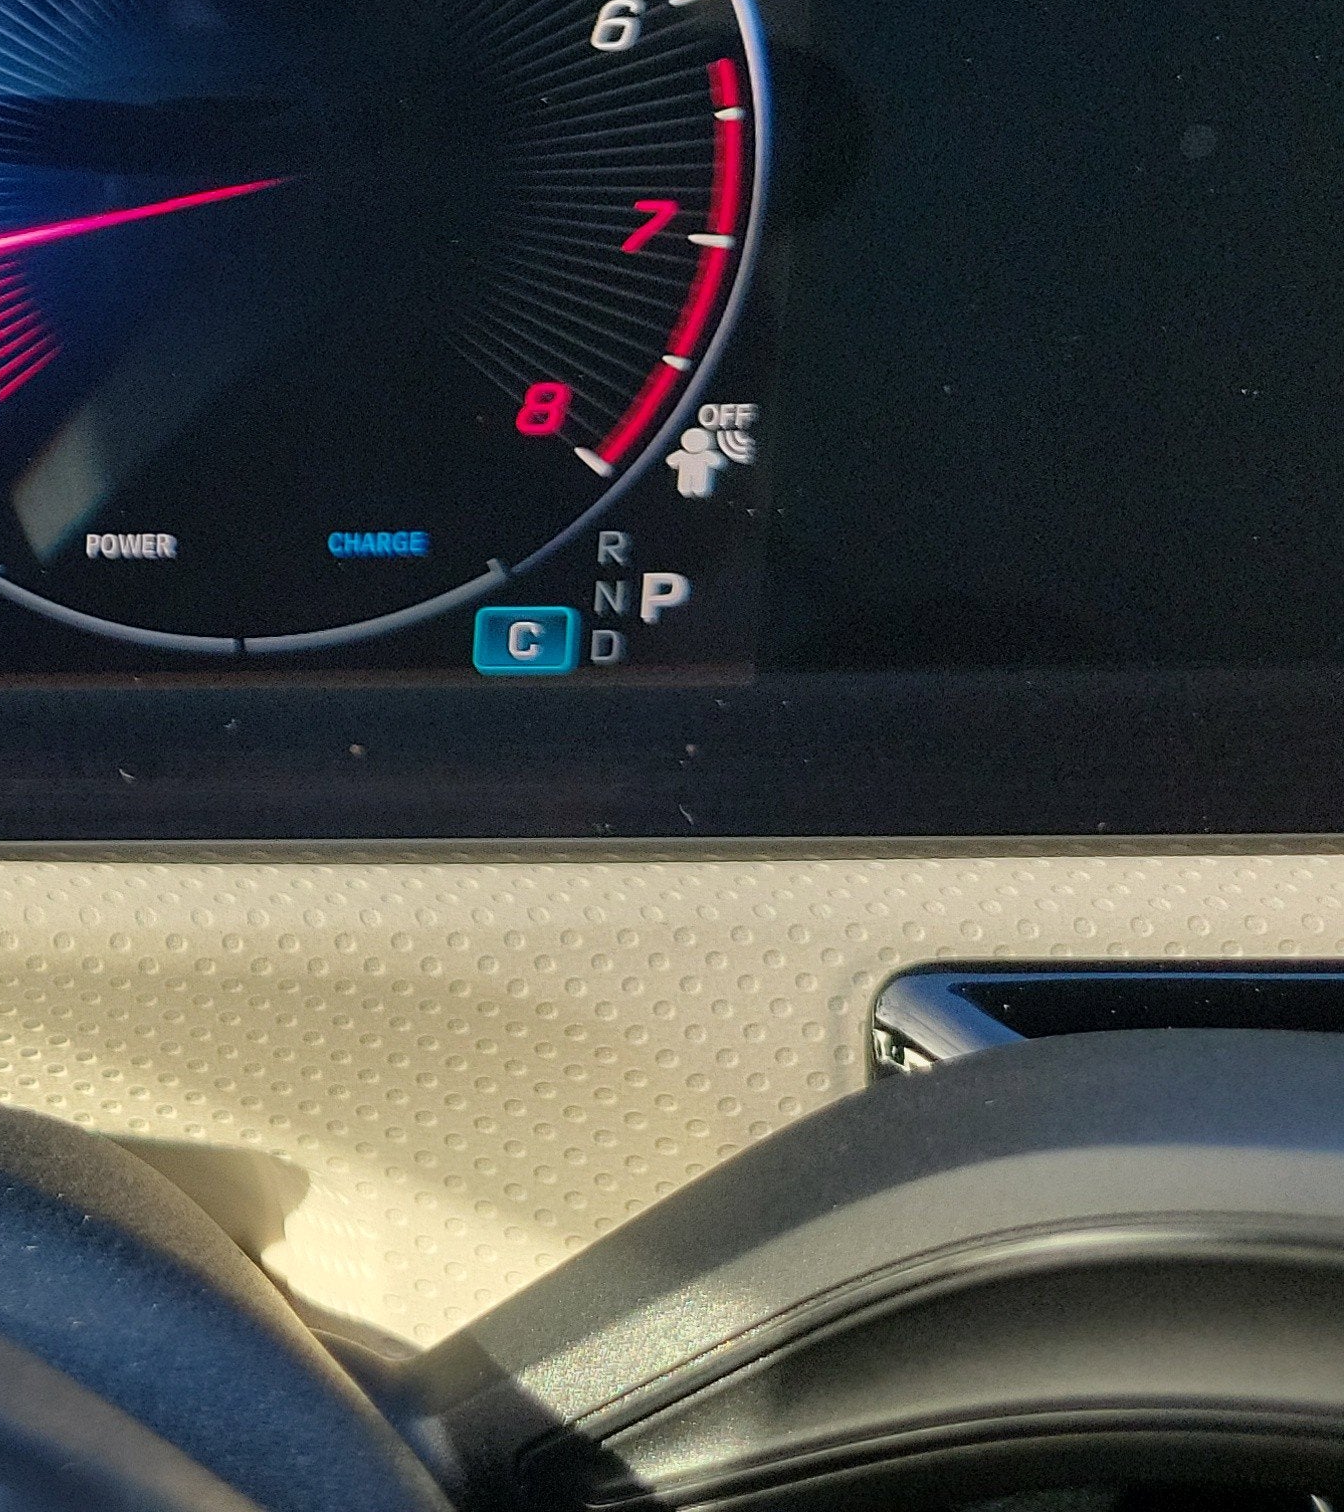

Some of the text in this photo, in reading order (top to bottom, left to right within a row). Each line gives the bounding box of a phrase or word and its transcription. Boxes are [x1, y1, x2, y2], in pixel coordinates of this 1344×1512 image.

[621, 199, 678, 254] 7
[515, 381, 571, 436] 8
[698, 403, 756, 430] OFF
[85, 533, 177, 560] POWER
[327, 531, 428, 557] CHARGE
[597, 530, 627, 566] R
[593, 580, 625, 616] N
[640, 572, 688, 623] P
[508, 621, 541, 660] C
[590, 629, 621, 664] D
